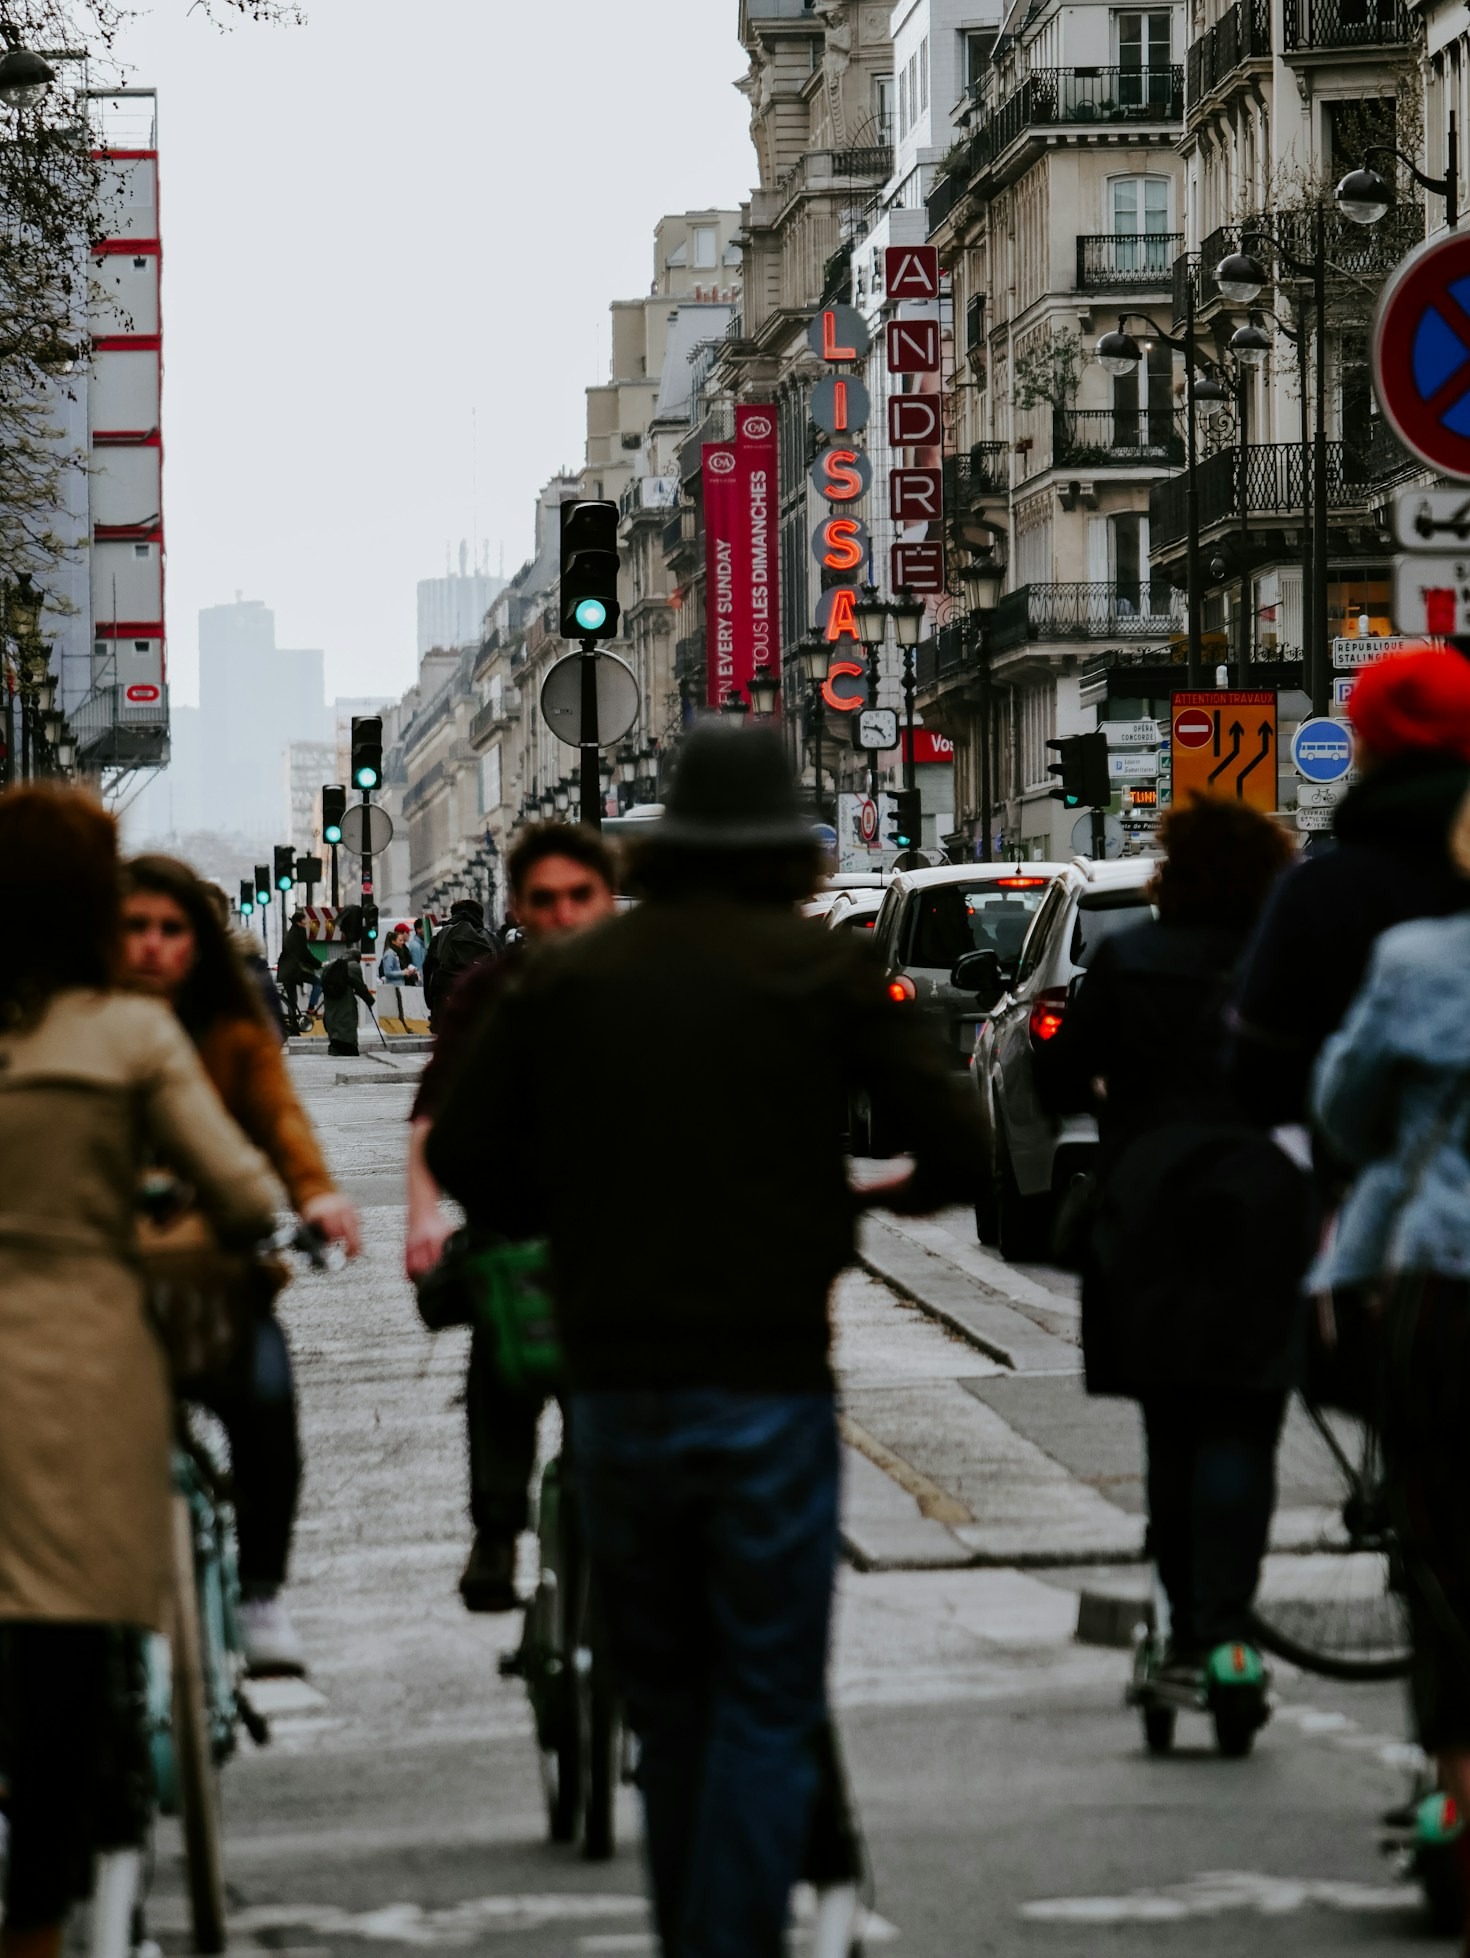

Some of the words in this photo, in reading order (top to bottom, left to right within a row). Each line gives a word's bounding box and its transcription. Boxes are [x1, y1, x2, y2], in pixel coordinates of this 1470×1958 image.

[750, 470, 768, 583] DIMANCHES
[821, 310, 865, 712] LISSAC
[716, 538, 733, 613] SUNDAY
[752, 585, 768, 619] LES
[718, 617, 733, 676] EVERY
[1338, 641, 1404, 652] RÉPUBLIQUE
[1174, 693, 1227, 704] ATTENTION
[1228, 693, 1274, 704] TRAVAUX
[1133, 724, 1153, 732] OPÉRA
